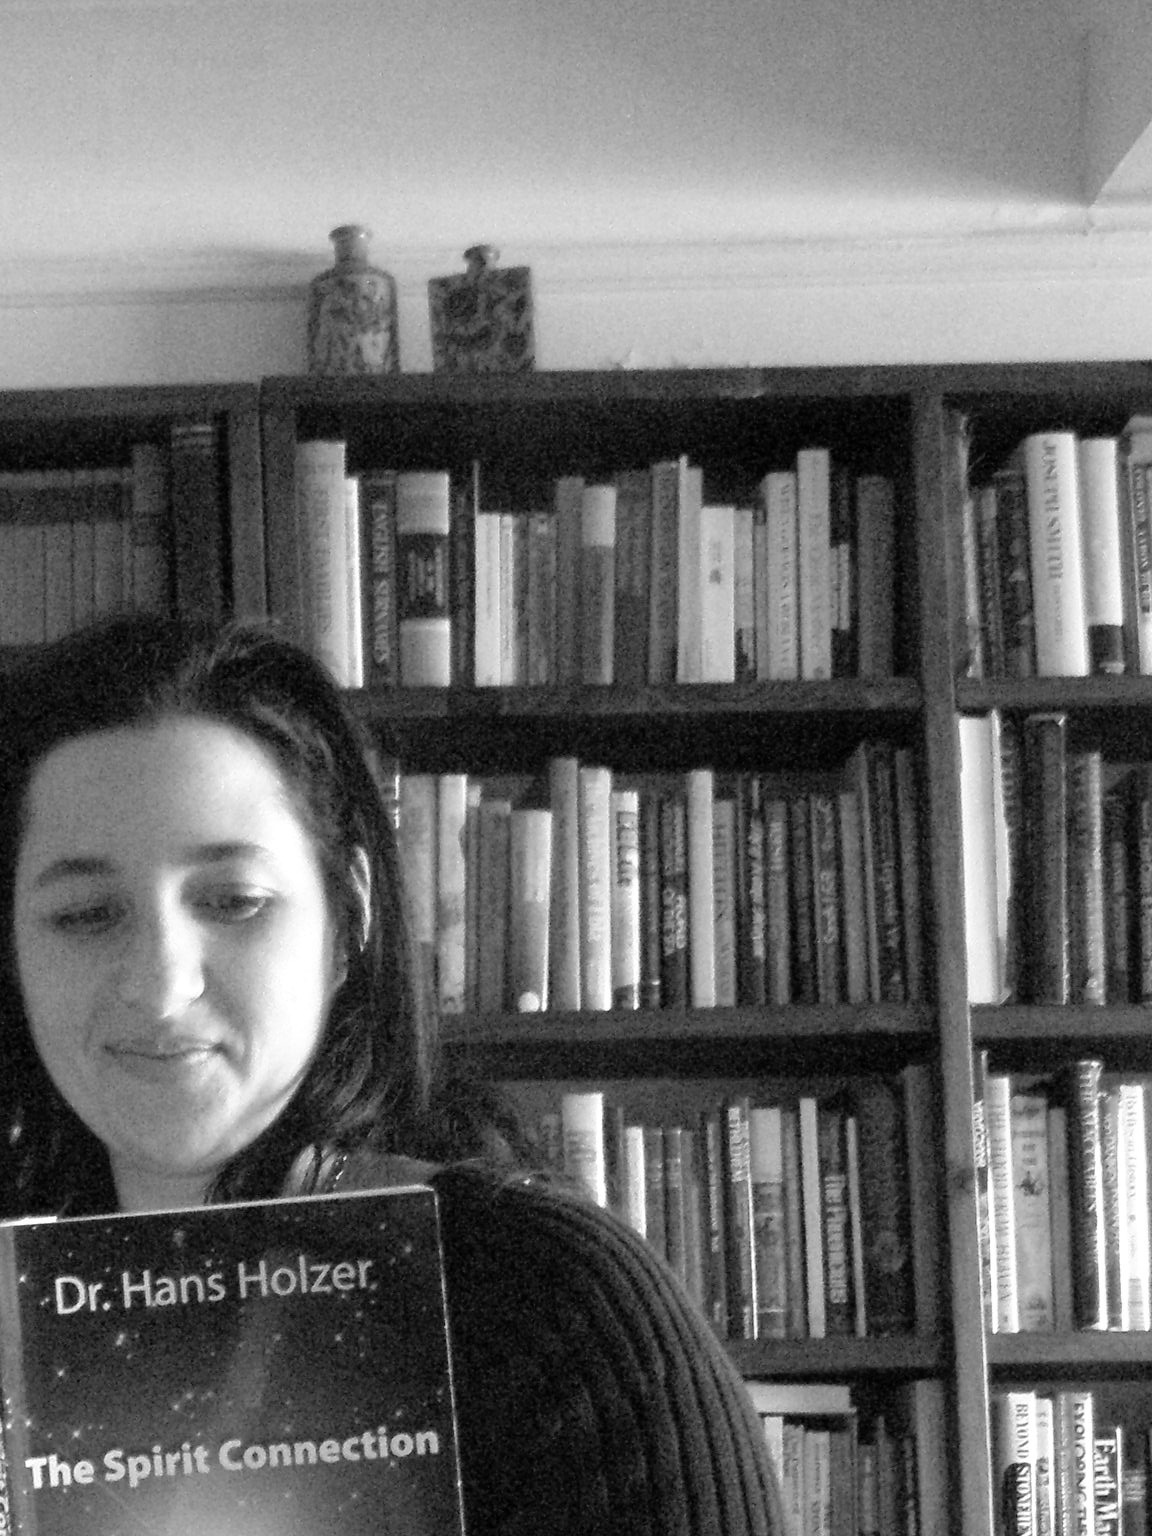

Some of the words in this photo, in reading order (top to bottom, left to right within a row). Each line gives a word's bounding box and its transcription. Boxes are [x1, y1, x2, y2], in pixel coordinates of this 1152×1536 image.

[1043, 441, 1060, 511] JOSEPH
[1047, 516, 1062, 579] SMITH
[55, 1275, 111, 1315] Dr.
[122, 1268, 226, 1309] Hans
[238, 1255, 375, 1298] Holzer
[25, 1453, 95, 1490] The
[103, 1443, 211, 1488] Spirit
[219, 1424, 441, 1472] Connection
[1015, 1402, 1030, 1460] BEYOND
[1093, 1438, 1118, 1496] Earth
